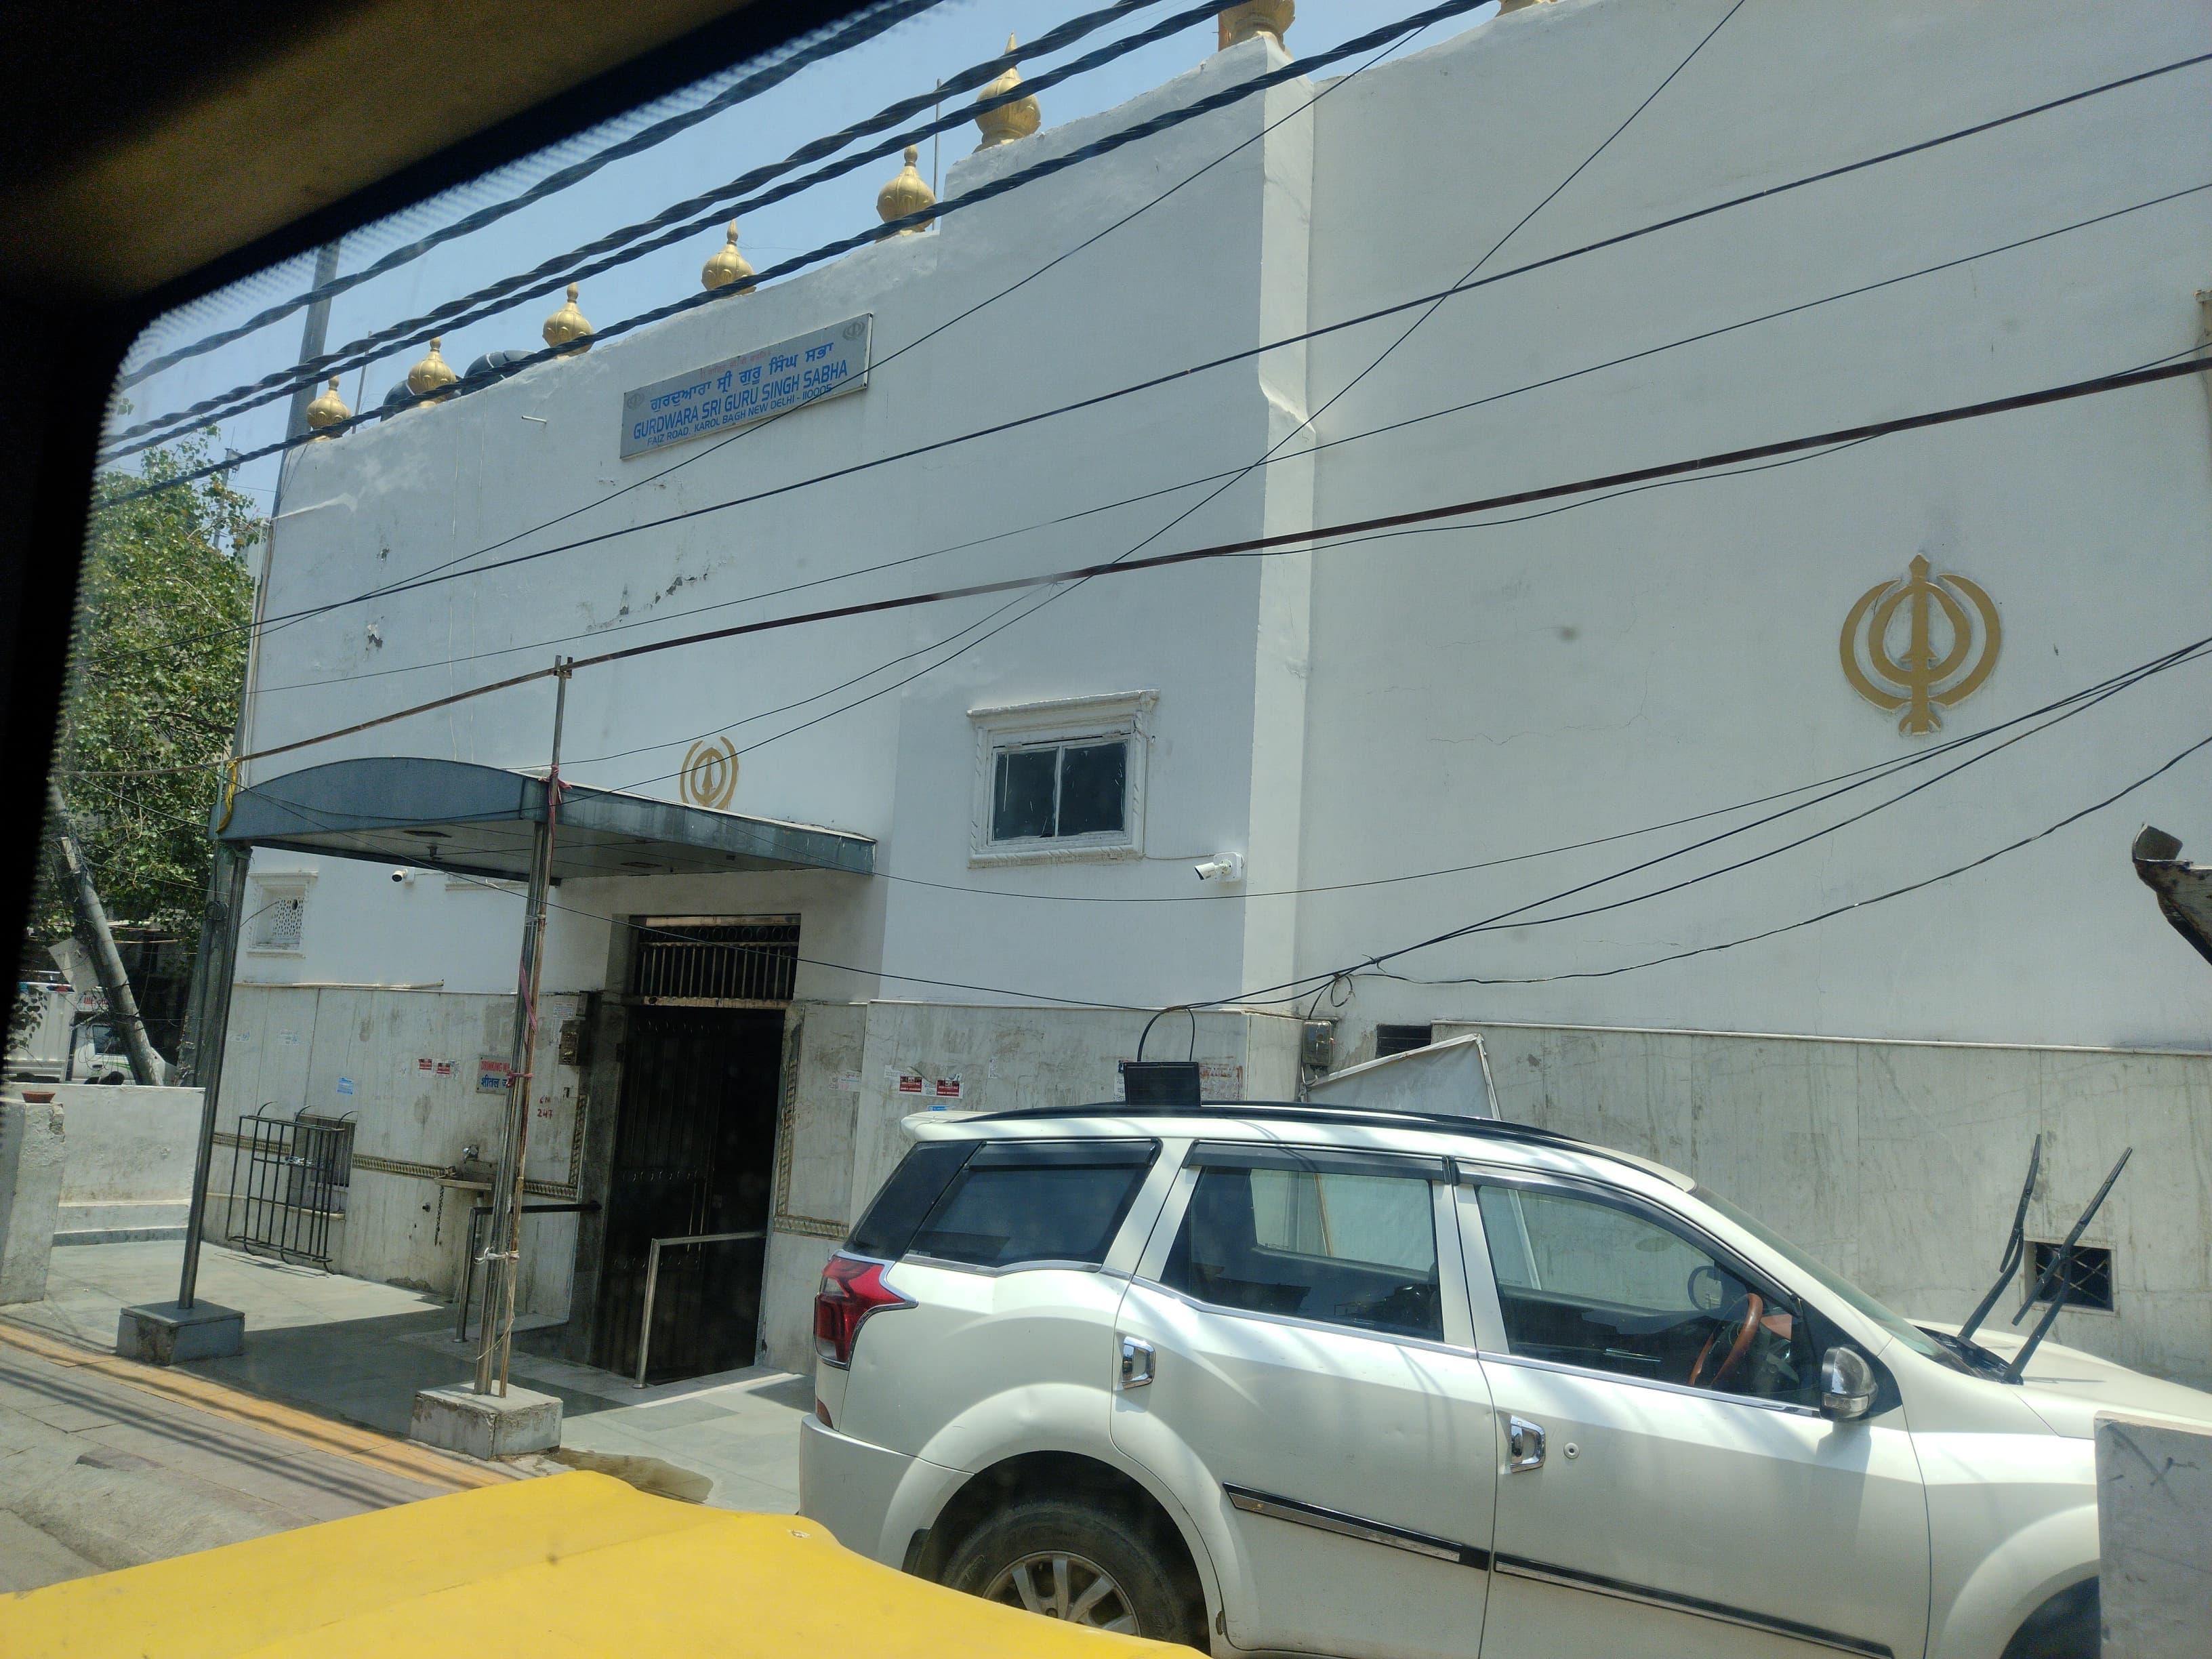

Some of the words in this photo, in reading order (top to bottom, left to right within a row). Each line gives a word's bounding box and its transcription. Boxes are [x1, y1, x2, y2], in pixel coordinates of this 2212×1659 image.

[739, 366, 762, 386] ਗੁਰੂ
[769, 354, 799, 375] ਸਿੰਘ
[805, 342, 834, 363] ਸਭਾ
[634, 405, 699, 440] GURDWARA
[701, 398, 722, 419] SRI
[724, 386, 759, 412] GURU
[761, 373, 800, 402] SINGH
[803, 359, 848, 389] SABHA
[647, 433, 665, 447] FAIZ
[694, 417, 720, 432] KAROL
[722, 410, 746, 424] BAGH
[747, 402, 769, 417] NEW
[770, 394, 795, 409] DELHI
[802, 383, 833, 401] 110005
[481, 1074, 500, 1088] शीतल
